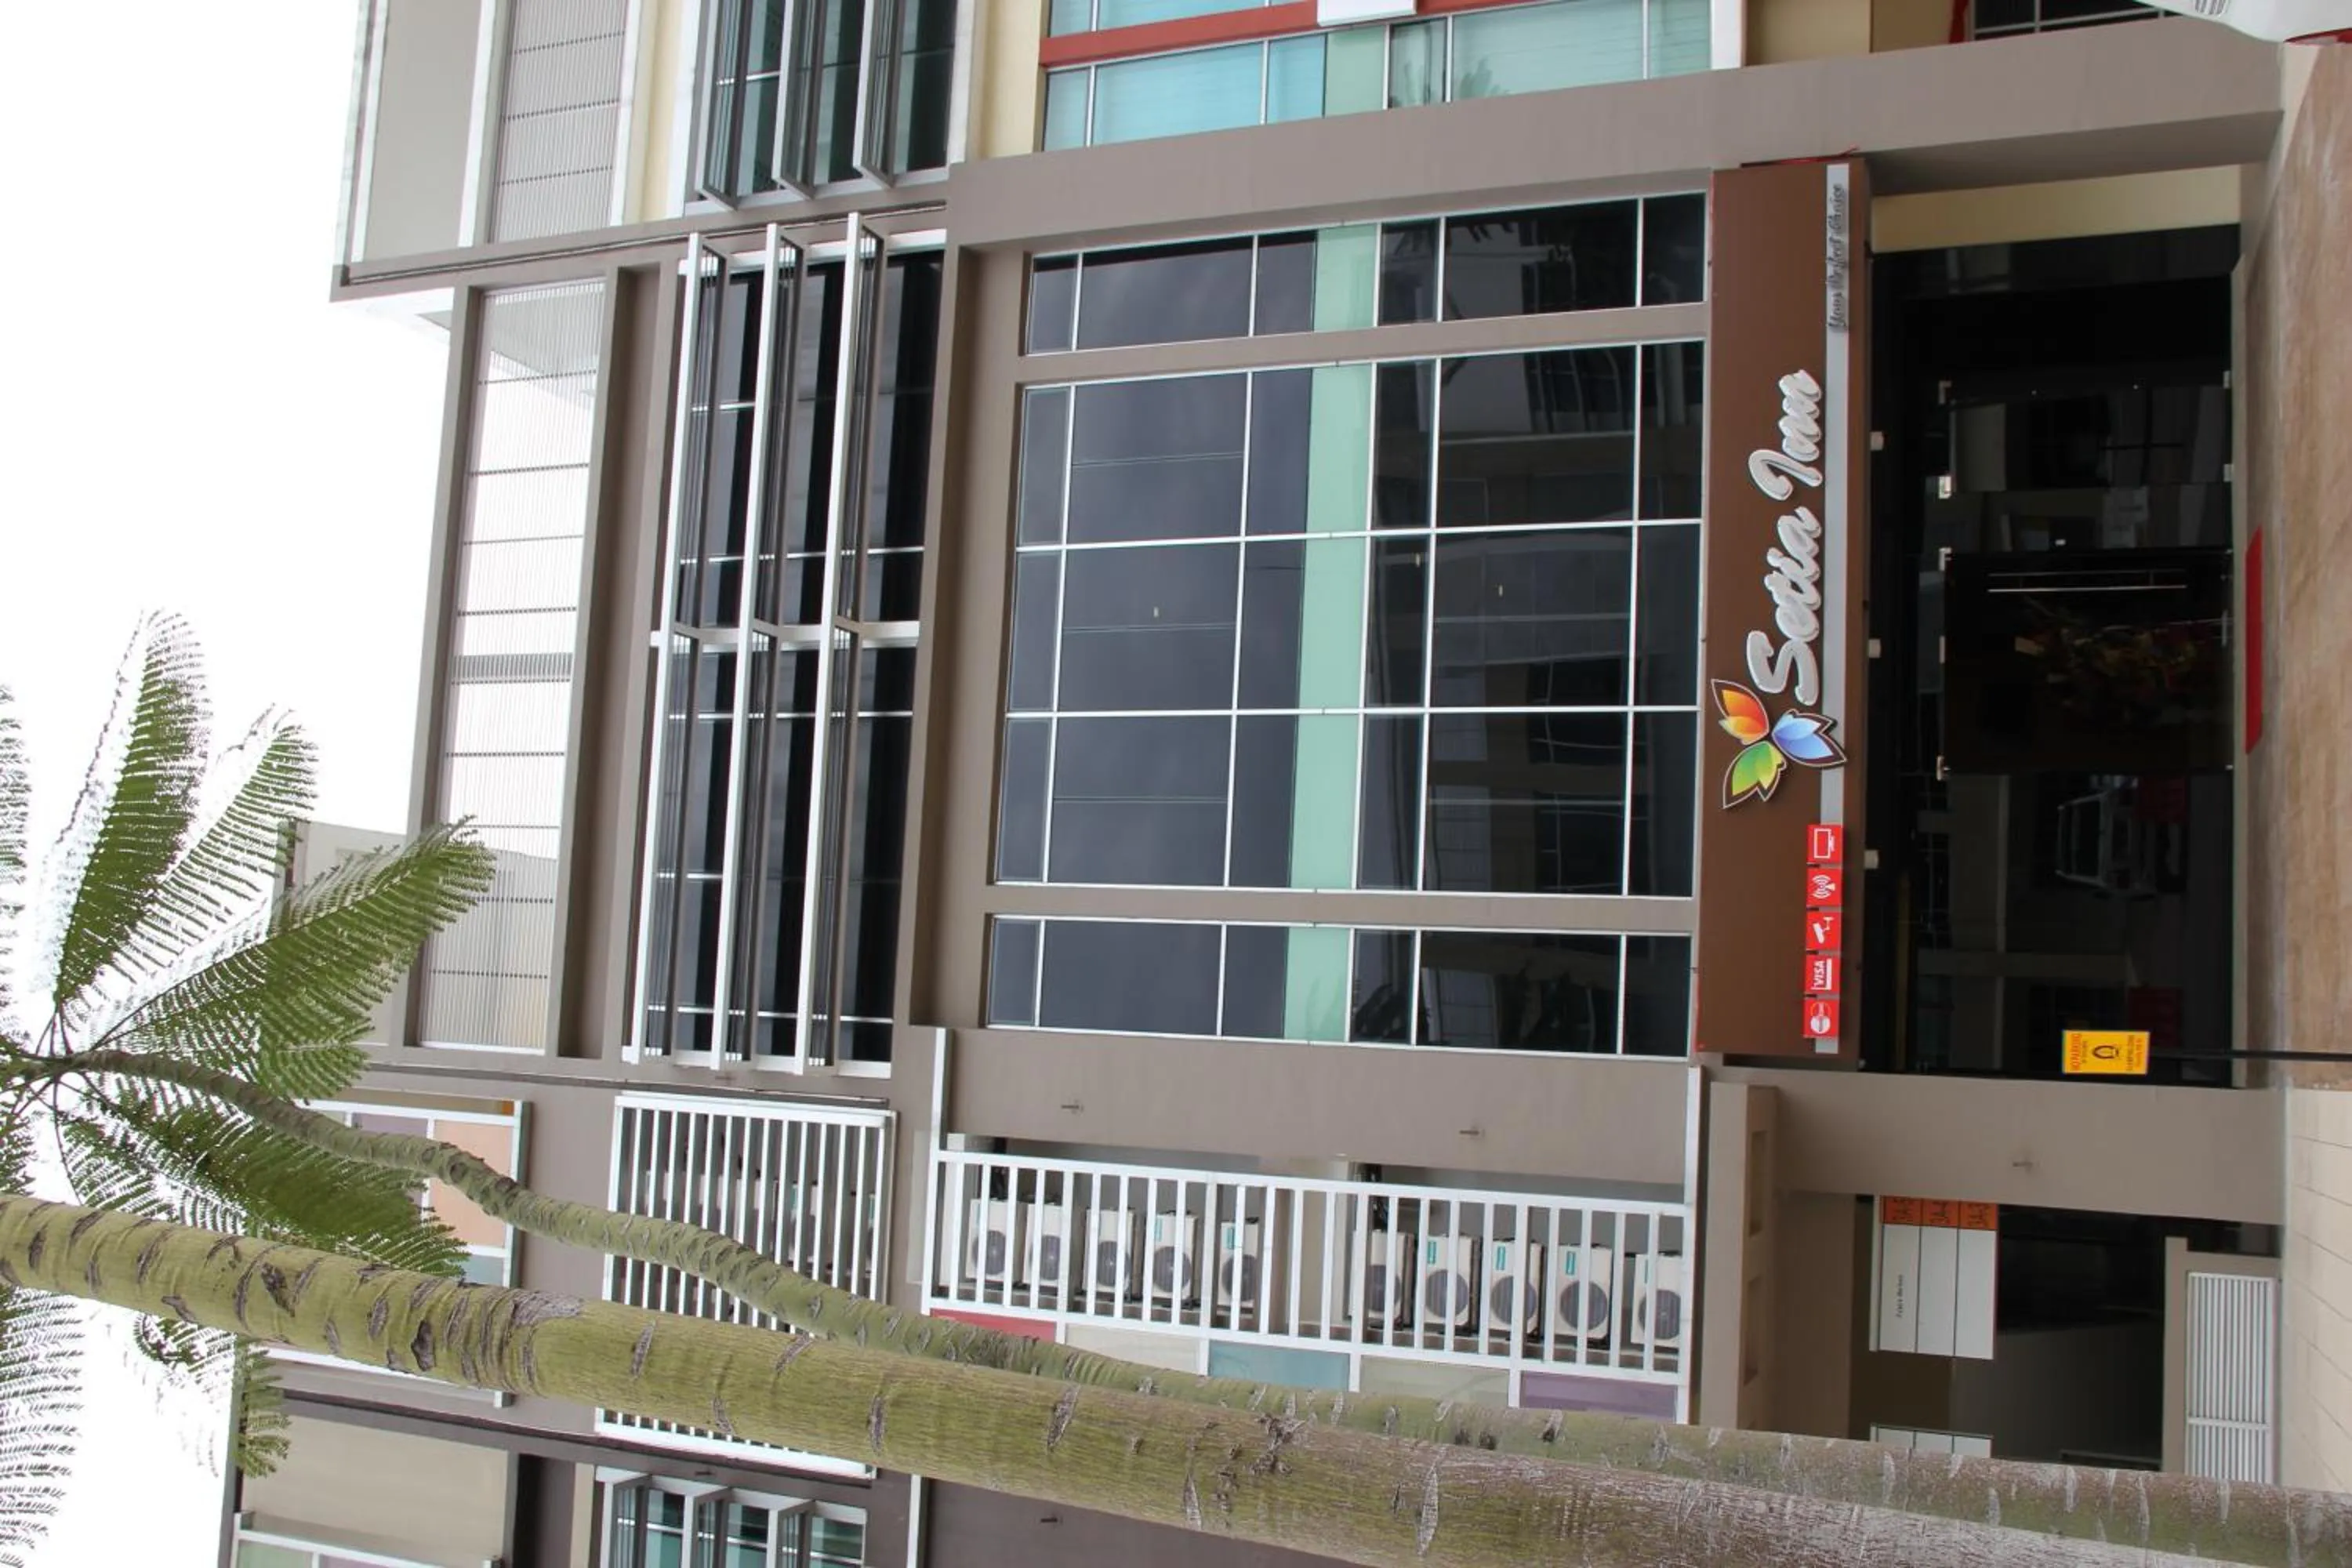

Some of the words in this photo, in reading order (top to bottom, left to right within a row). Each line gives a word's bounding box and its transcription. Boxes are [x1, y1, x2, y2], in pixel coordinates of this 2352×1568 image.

[1828, 184, 1845, 232] Choice
[1827, 236, 1847, 289] Perfect
[1827, 292, 1846, 331] Your
[1748, 369, 1824, 501] Inn
[1747, 506, 1822, 706] Setia
[1813, 960, 1826, 987] VISA
